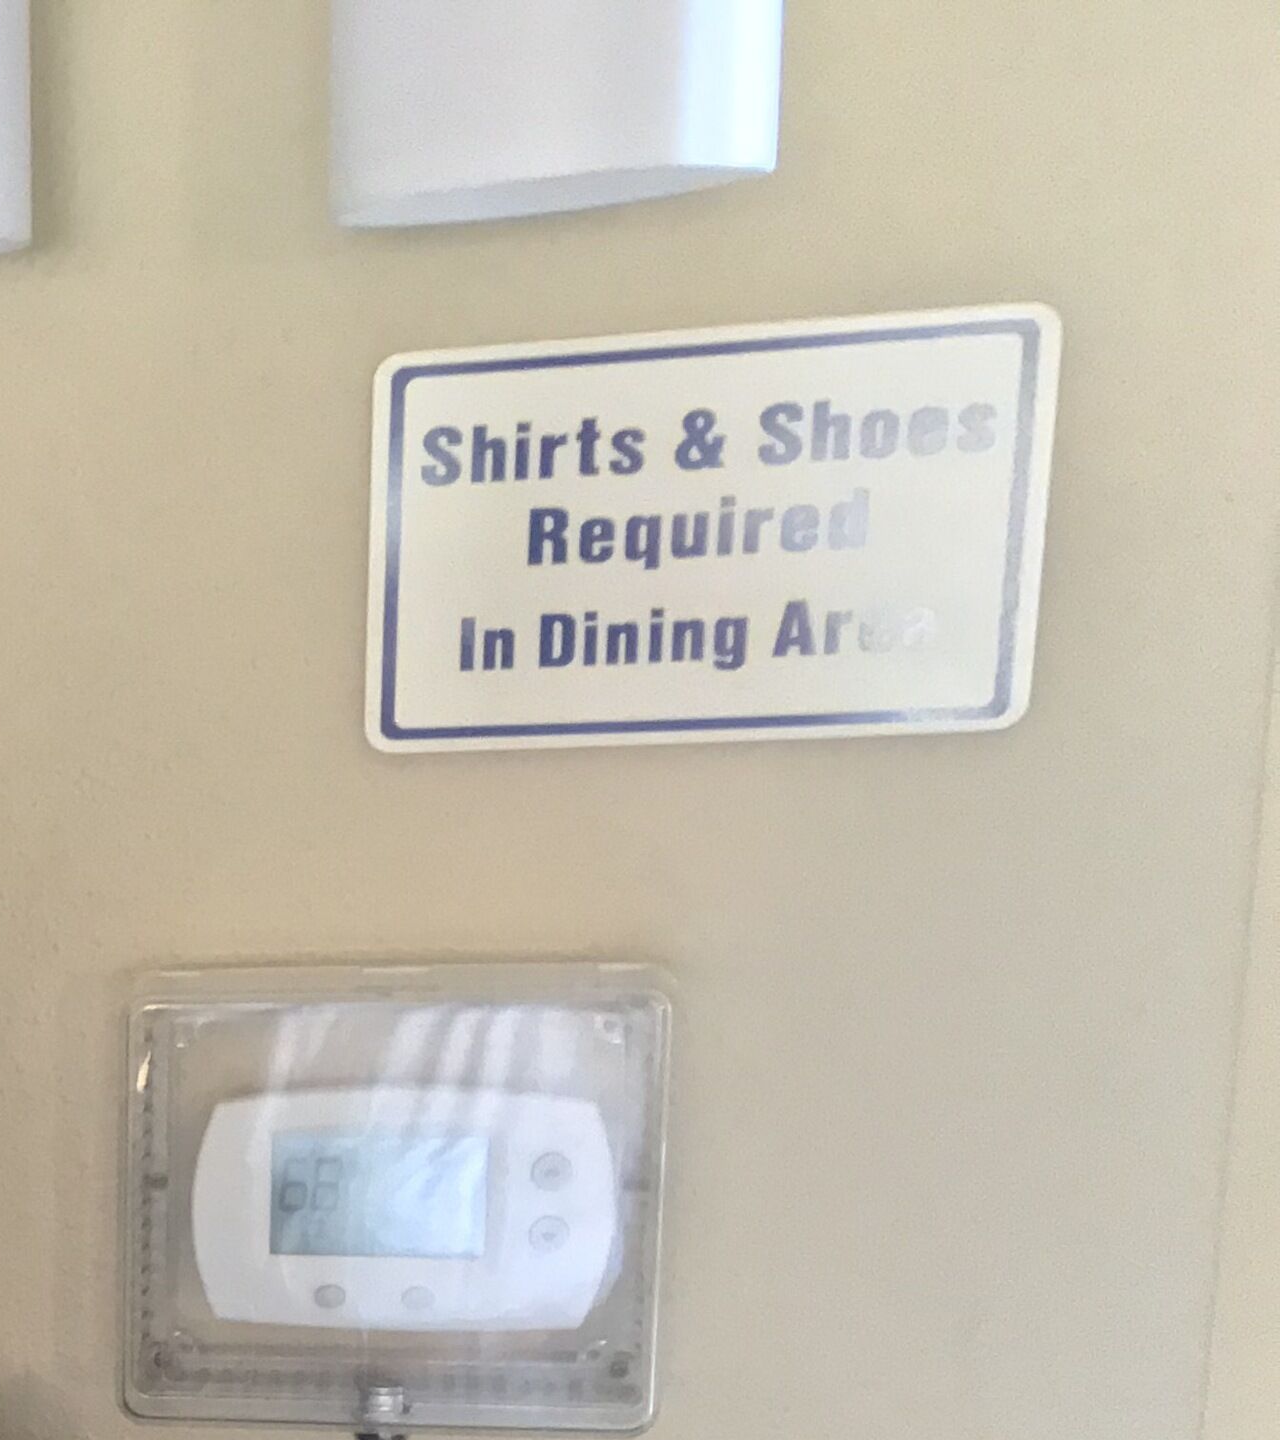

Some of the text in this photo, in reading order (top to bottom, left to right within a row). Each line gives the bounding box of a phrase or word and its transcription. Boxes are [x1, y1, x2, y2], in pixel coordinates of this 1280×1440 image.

[420, 400, 999, 487] Shirts & Shoes
[526, 487, 871, 571] Required
[459, 598, 938, 672] In Dining Ar
